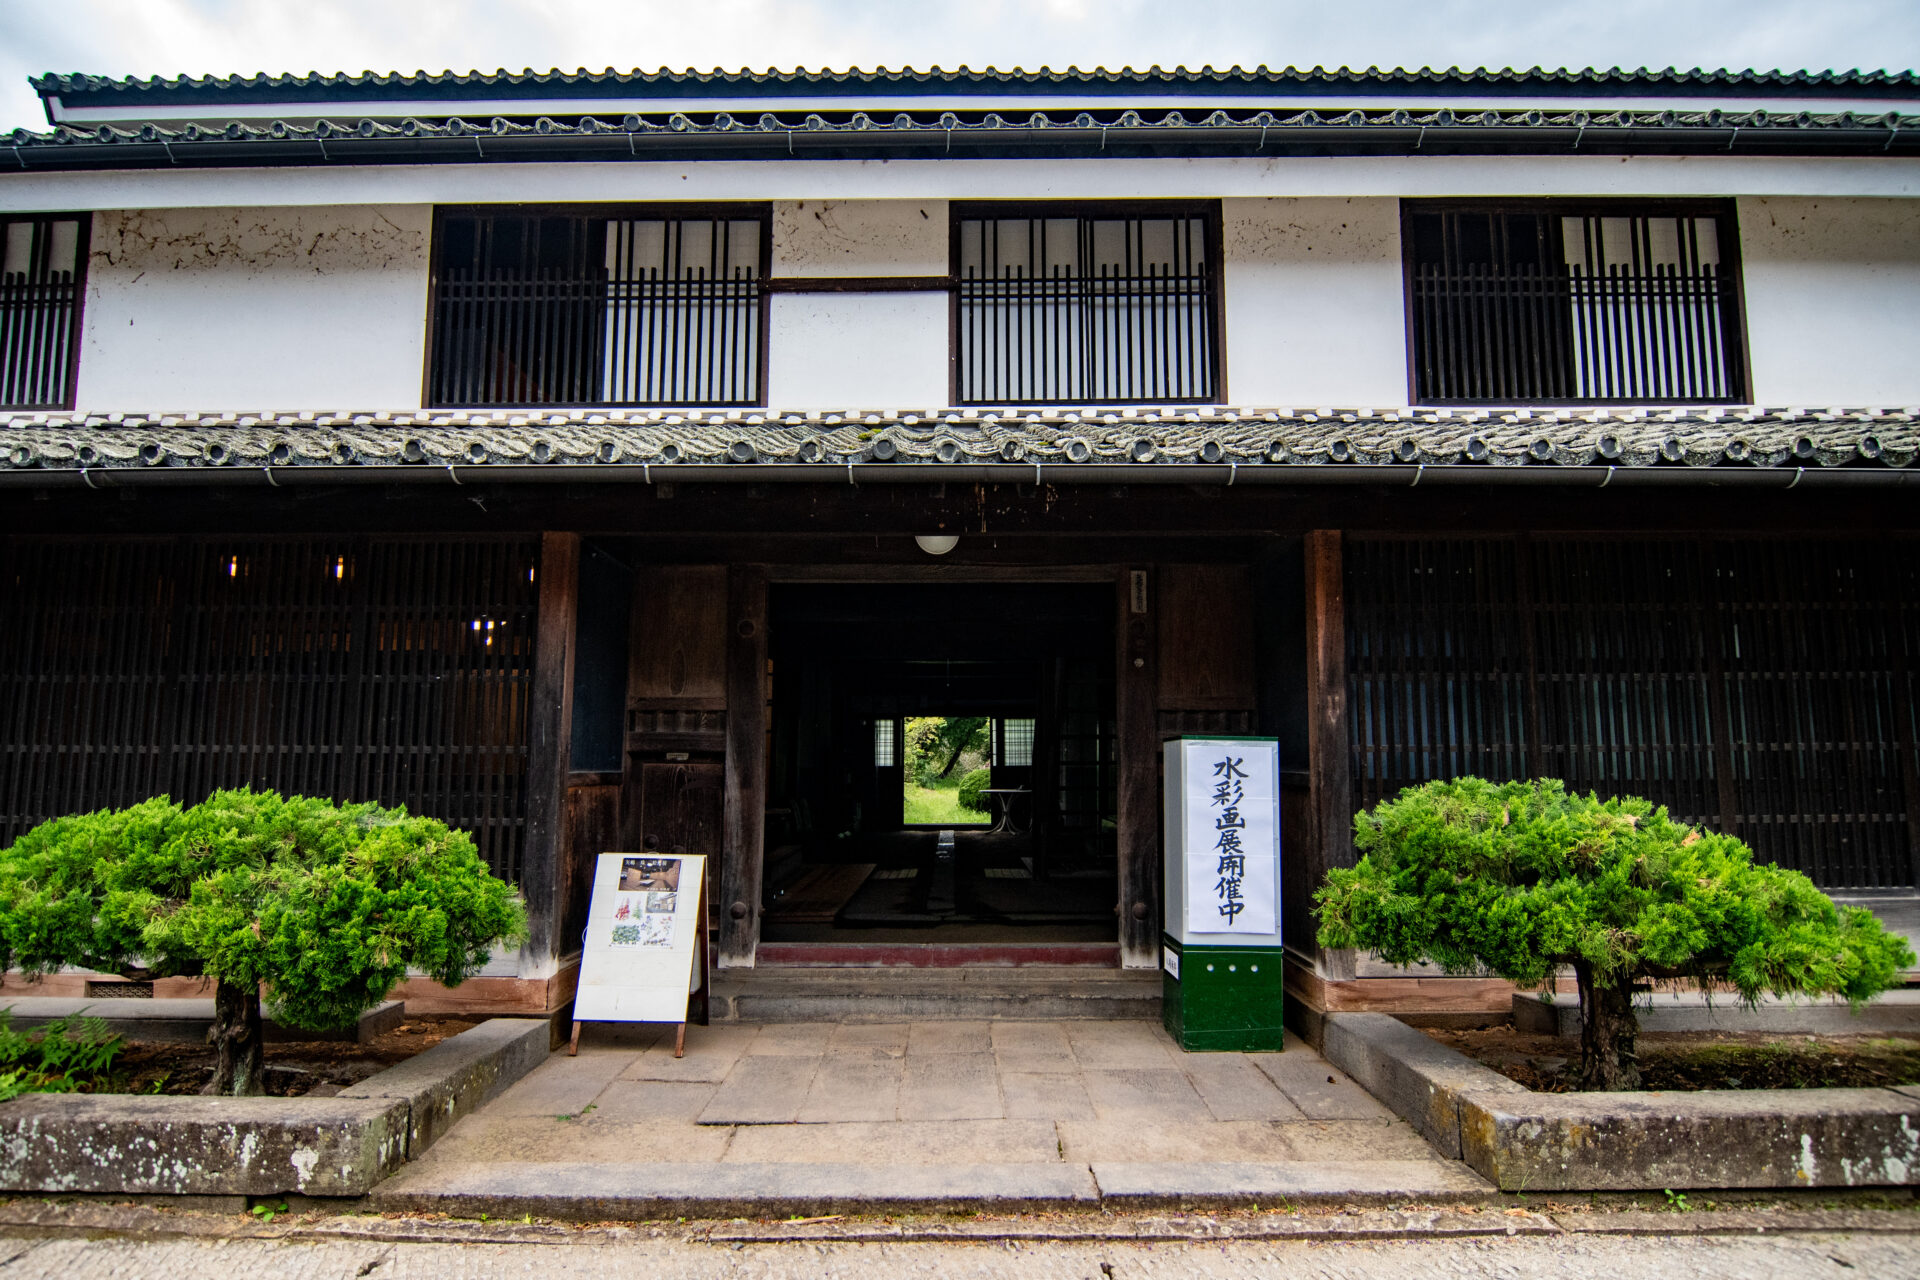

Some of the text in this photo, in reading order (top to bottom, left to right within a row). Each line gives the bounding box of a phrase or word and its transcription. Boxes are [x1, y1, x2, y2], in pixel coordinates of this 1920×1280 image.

[1210, 755, 1250, 927] 水彩画展開催中
